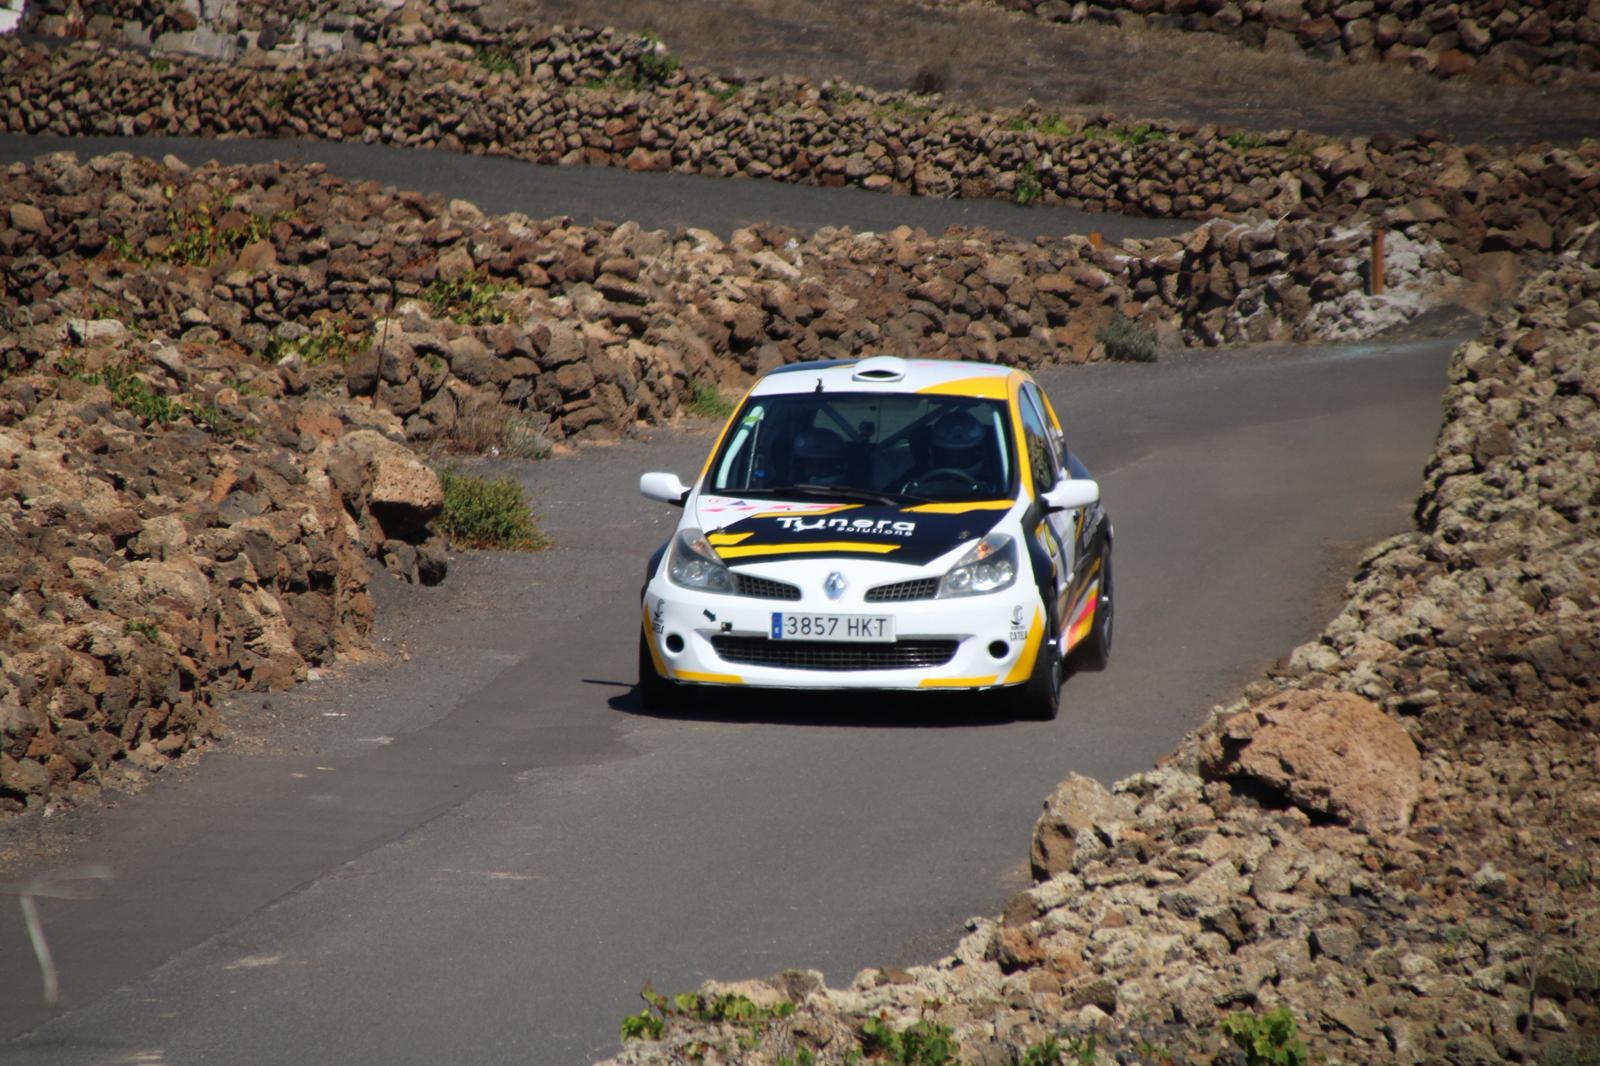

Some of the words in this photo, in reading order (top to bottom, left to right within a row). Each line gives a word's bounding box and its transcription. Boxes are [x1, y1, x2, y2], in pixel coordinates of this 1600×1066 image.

[777, 517, 916, 532] Tunera
[836, 526, 913, 537] solutions
[786, 616, 839, 636] 3857
[847, 618, 887, 638] HKT
